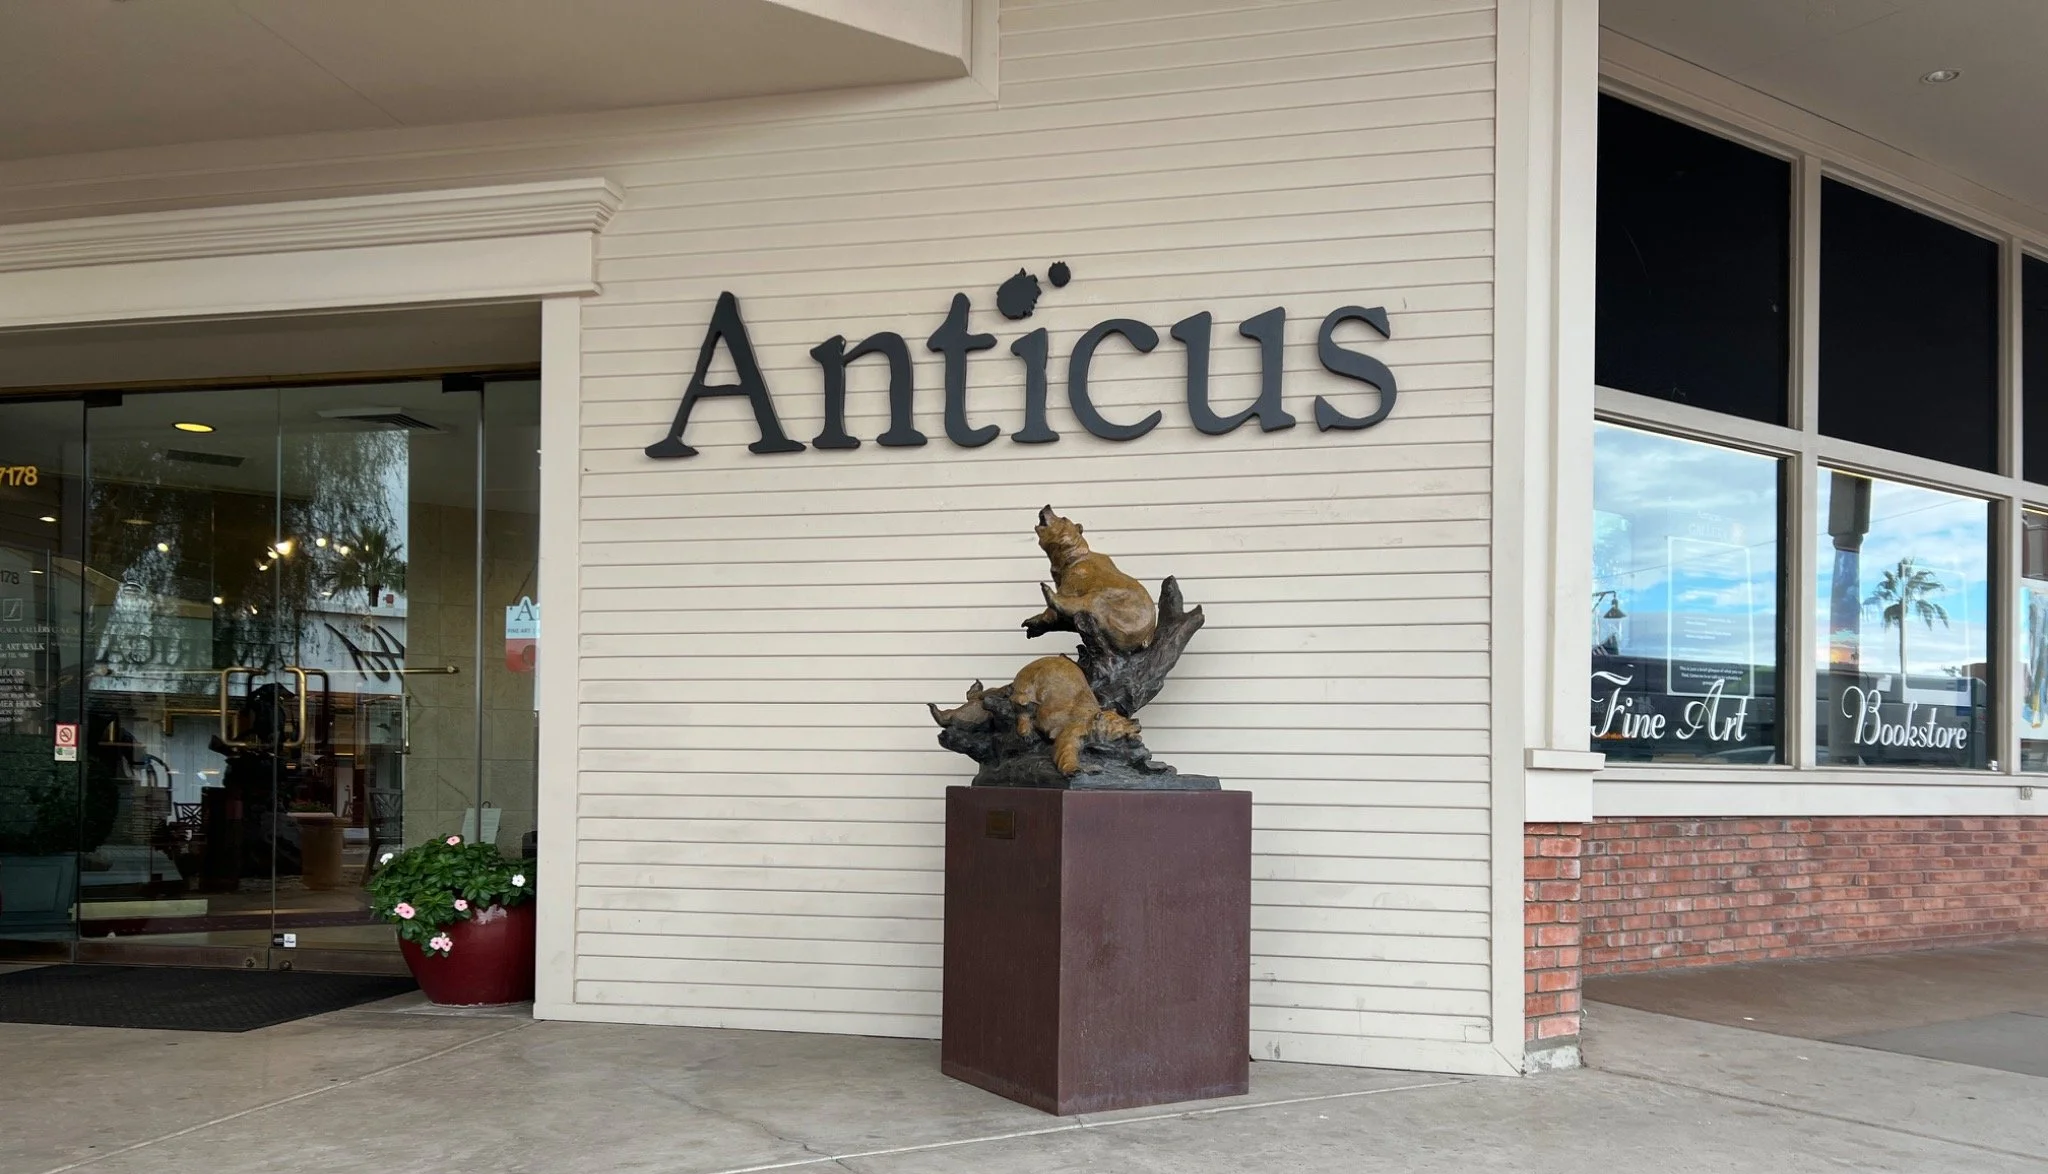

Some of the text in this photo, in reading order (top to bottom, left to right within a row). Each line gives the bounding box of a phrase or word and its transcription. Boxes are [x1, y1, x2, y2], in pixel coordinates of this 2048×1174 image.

[644, 262, 1398, 458] Anticus
[1591, 671, 1968, 749] Fine Art Bookstore
